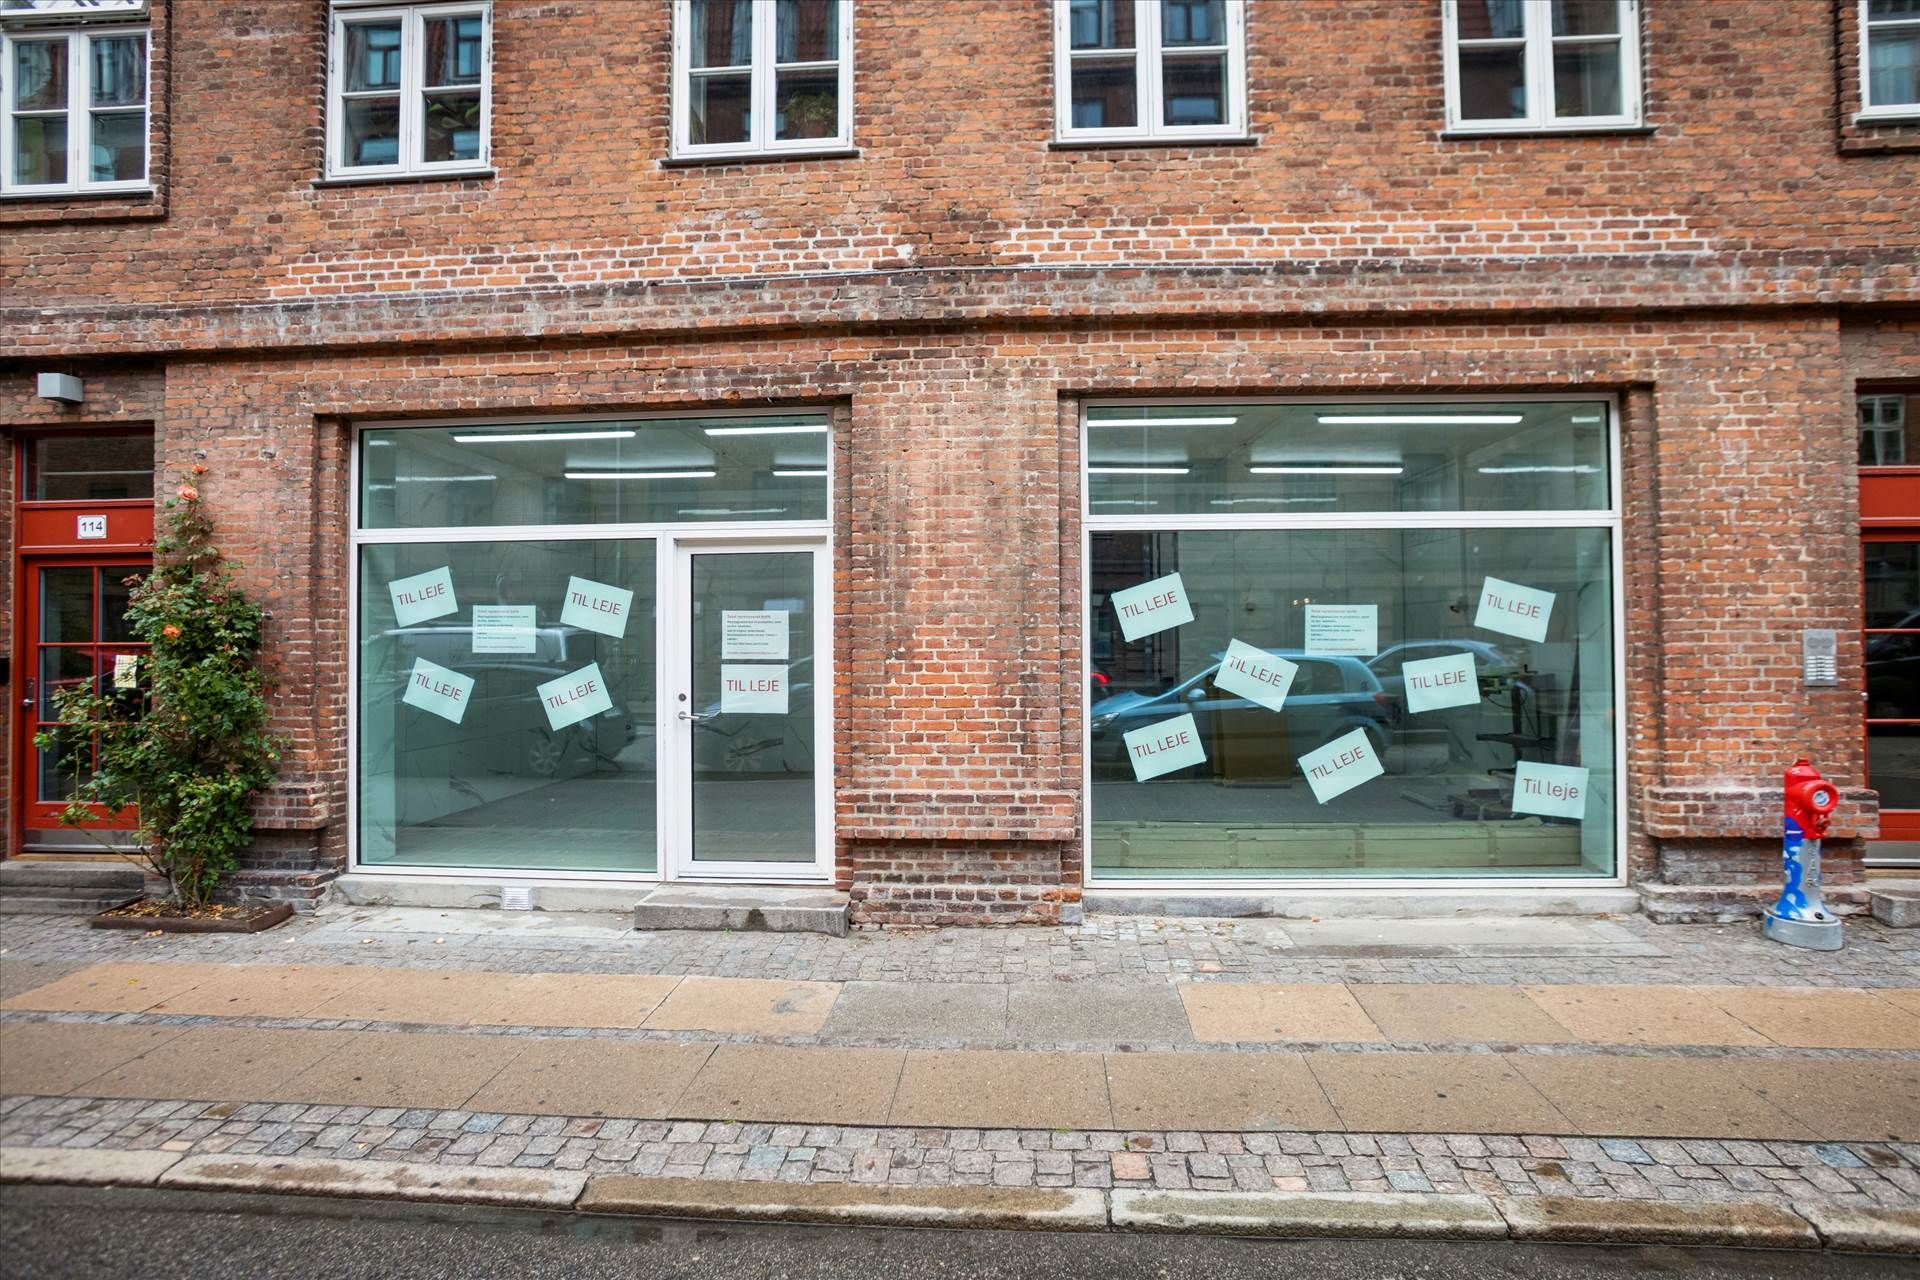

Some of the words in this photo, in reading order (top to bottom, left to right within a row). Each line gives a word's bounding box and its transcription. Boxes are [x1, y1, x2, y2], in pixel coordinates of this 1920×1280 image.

[82, 522, 103, 532] 114
[397, 592, 416, 605] TIL
[419, 583, 445, 601] LEJE
[572, 592, 588, 607] TIL
[592, 598, 621, 615] LEJE
[1121, 603, 1144, 618] TIL
[1145, 591, 1177, 611] LEJE
[1488, 594, 1504, 609] TIL
[1508, 600, 1541, 618] LEJE
[1229, 656, 1246, 673] TIL
[1251, 665, 1282, 687] LEJE
[1410, 677, 1432, 689] TIL
[1435, 670, 1466, 686] LEJE
[416, 673, 431, 689] TIL
[434, 681, 462, 701] LEJE
[547, 694, 567, 708] TIL
[569, 681, 598, 701] LEJE
[726, 680, 746, 692] TIL
[750, 680, 779, 692] LEJE
[1133, 744, 1156, 758] TIL
[1157, 731, 1190, 751] LEJE
[1310, 764, 1334, 779] TIL
[1334, 747, 1365, 768] LEJE
[1523, 778, 1541, 794] Til
[1547, 781, 1579, 801] leje
